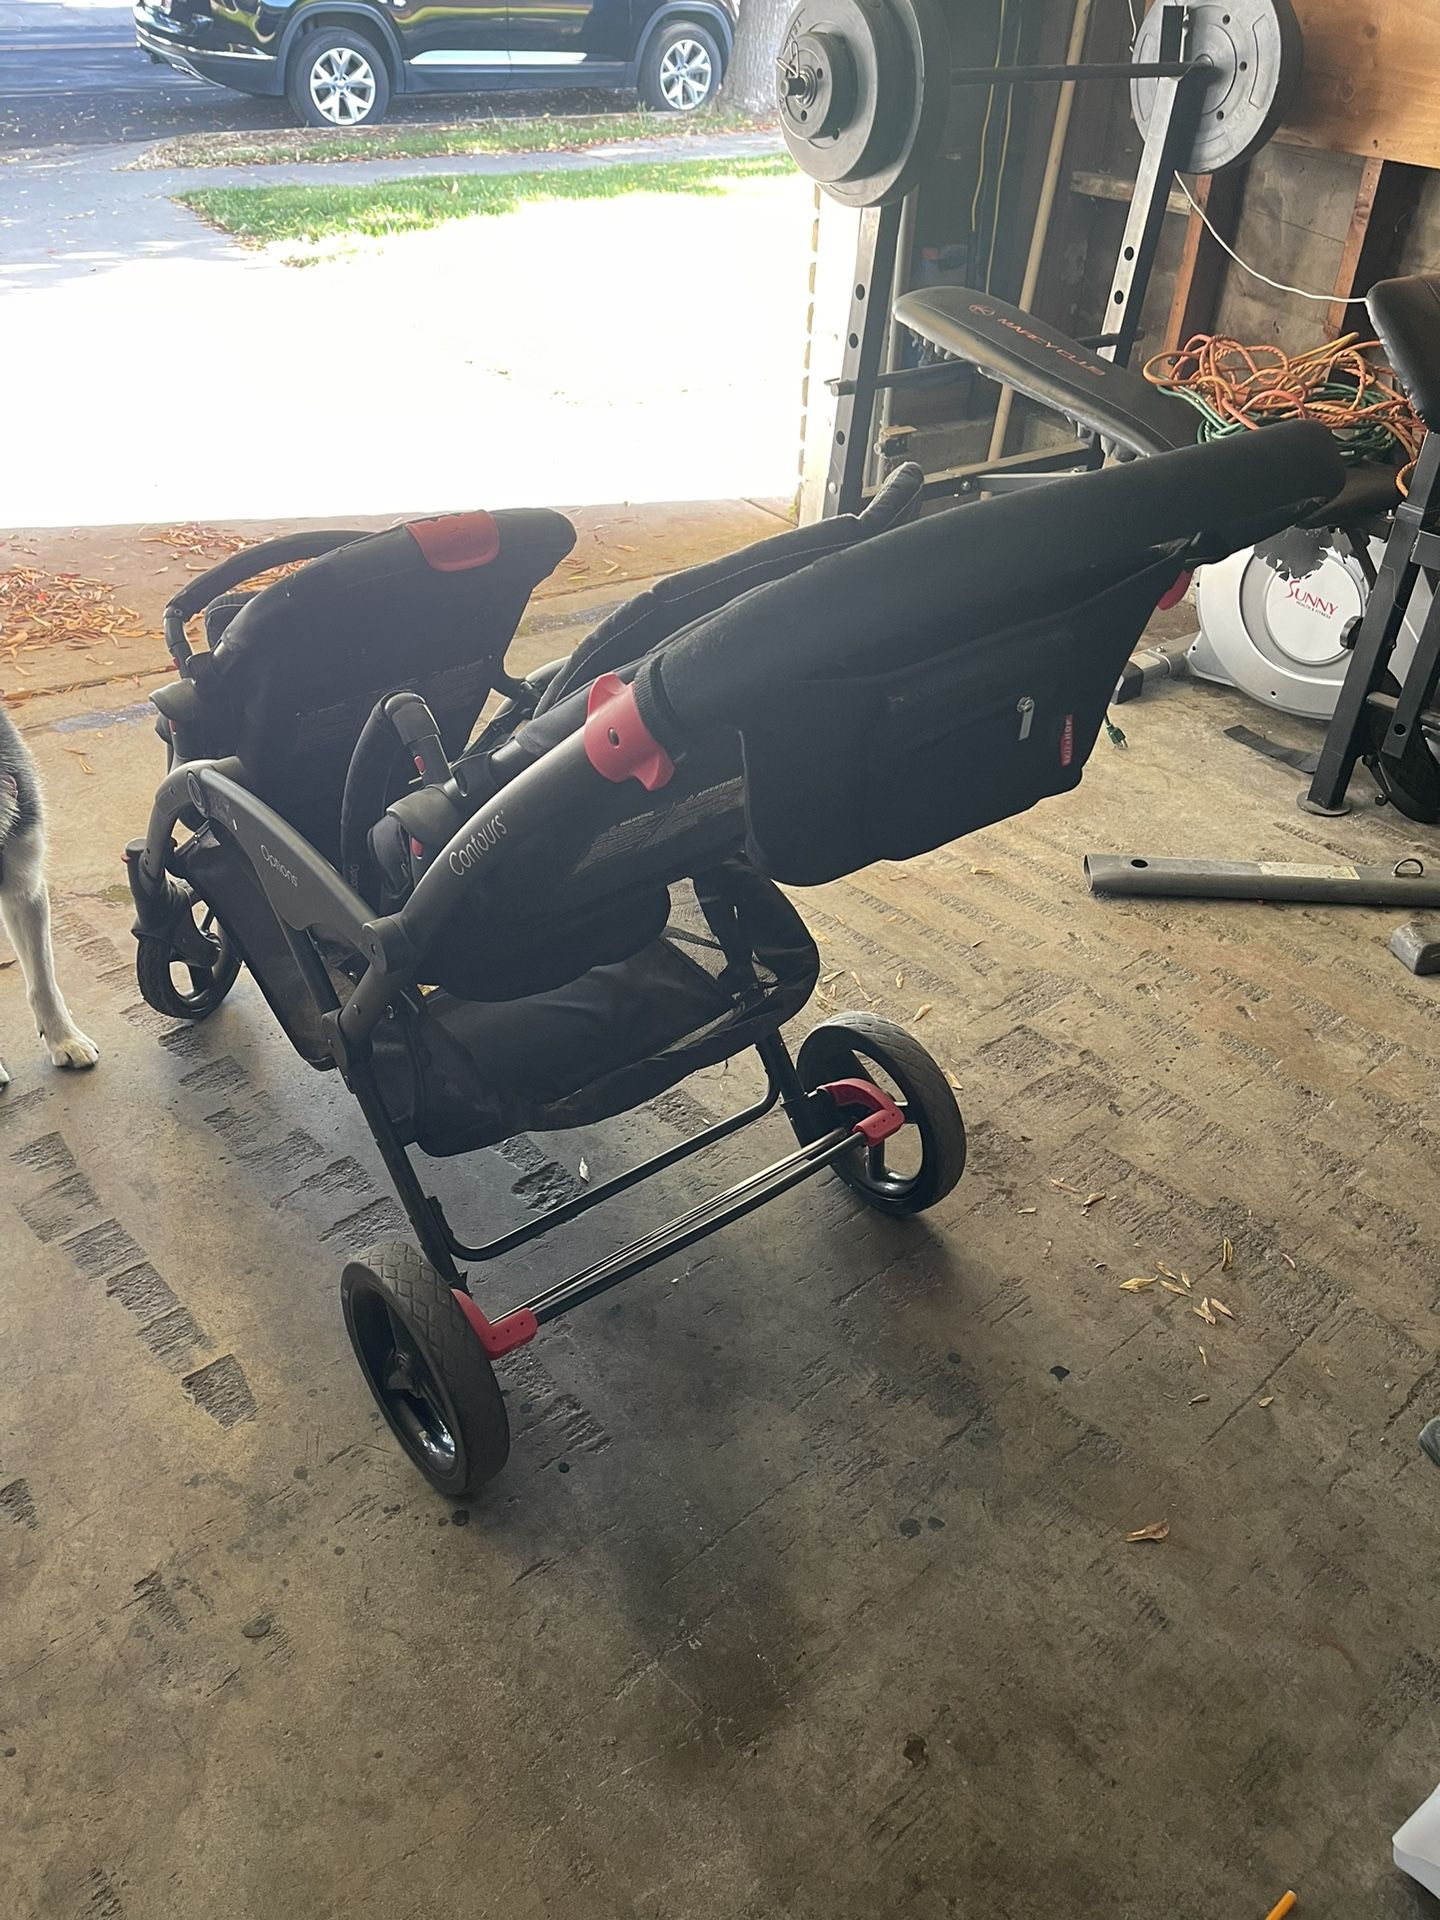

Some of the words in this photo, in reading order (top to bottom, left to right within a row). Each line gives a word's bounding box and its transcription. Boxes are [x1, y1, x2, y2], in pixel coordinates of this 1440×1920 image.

[1285, 580, 1339, 615] SUNNY
[260, 844, 298, 887] Options
[449, 814, 507, 876] Contours
